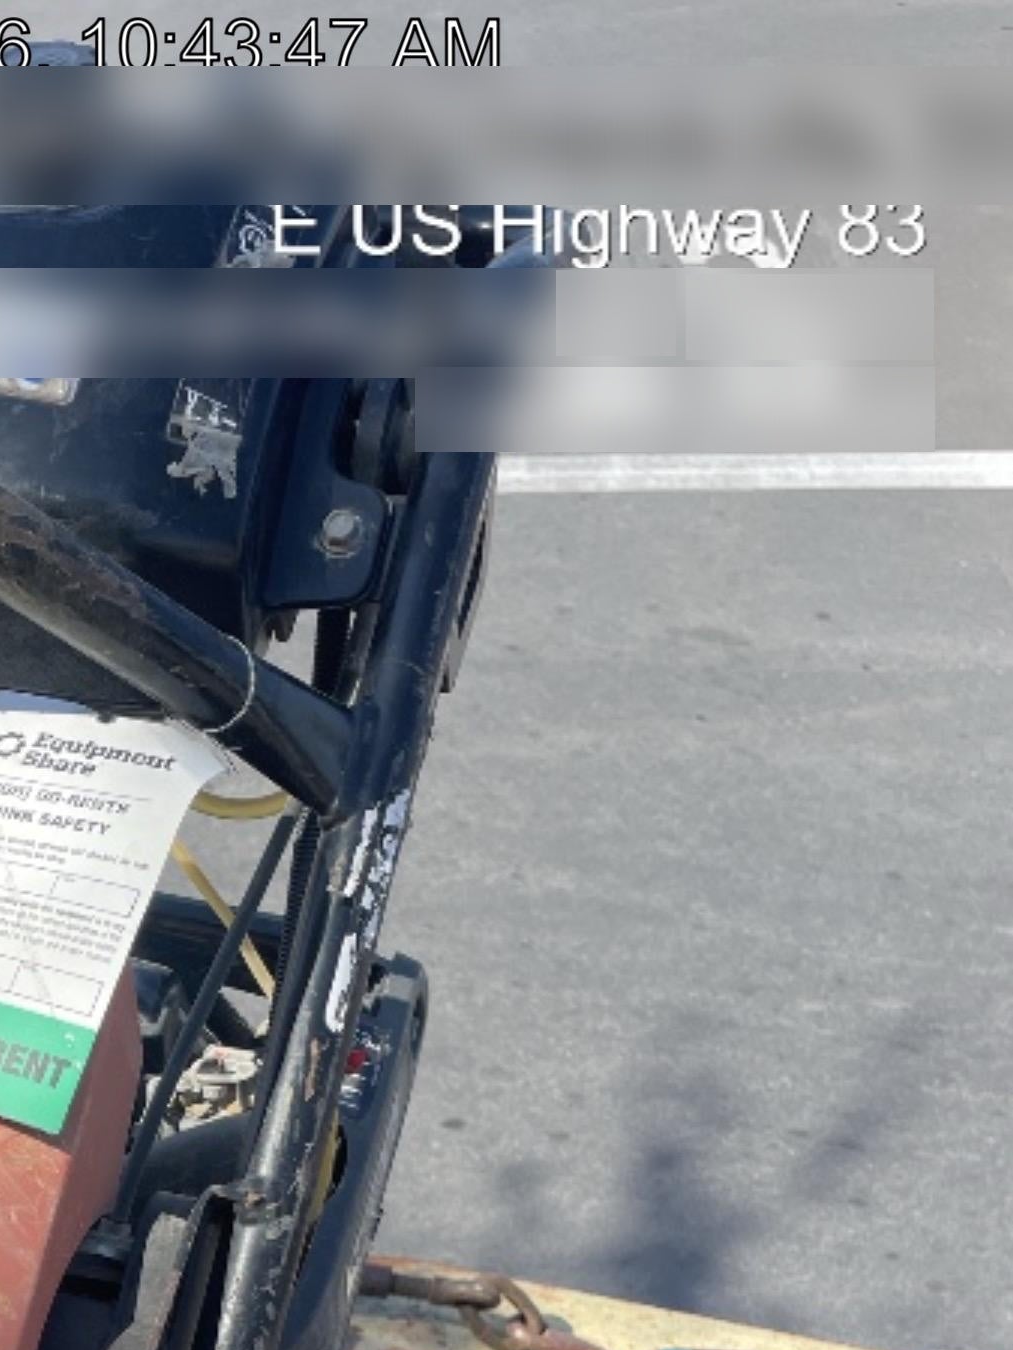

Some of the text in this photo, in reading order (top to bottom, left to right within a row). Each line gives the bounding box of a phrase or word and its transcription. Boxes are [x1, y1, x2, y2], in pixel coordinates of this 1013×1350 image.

[20, 750, 98, 776] Share
[31, 731, 178, 773] Equipment
[39, 812, 111, 835] SAFETY
